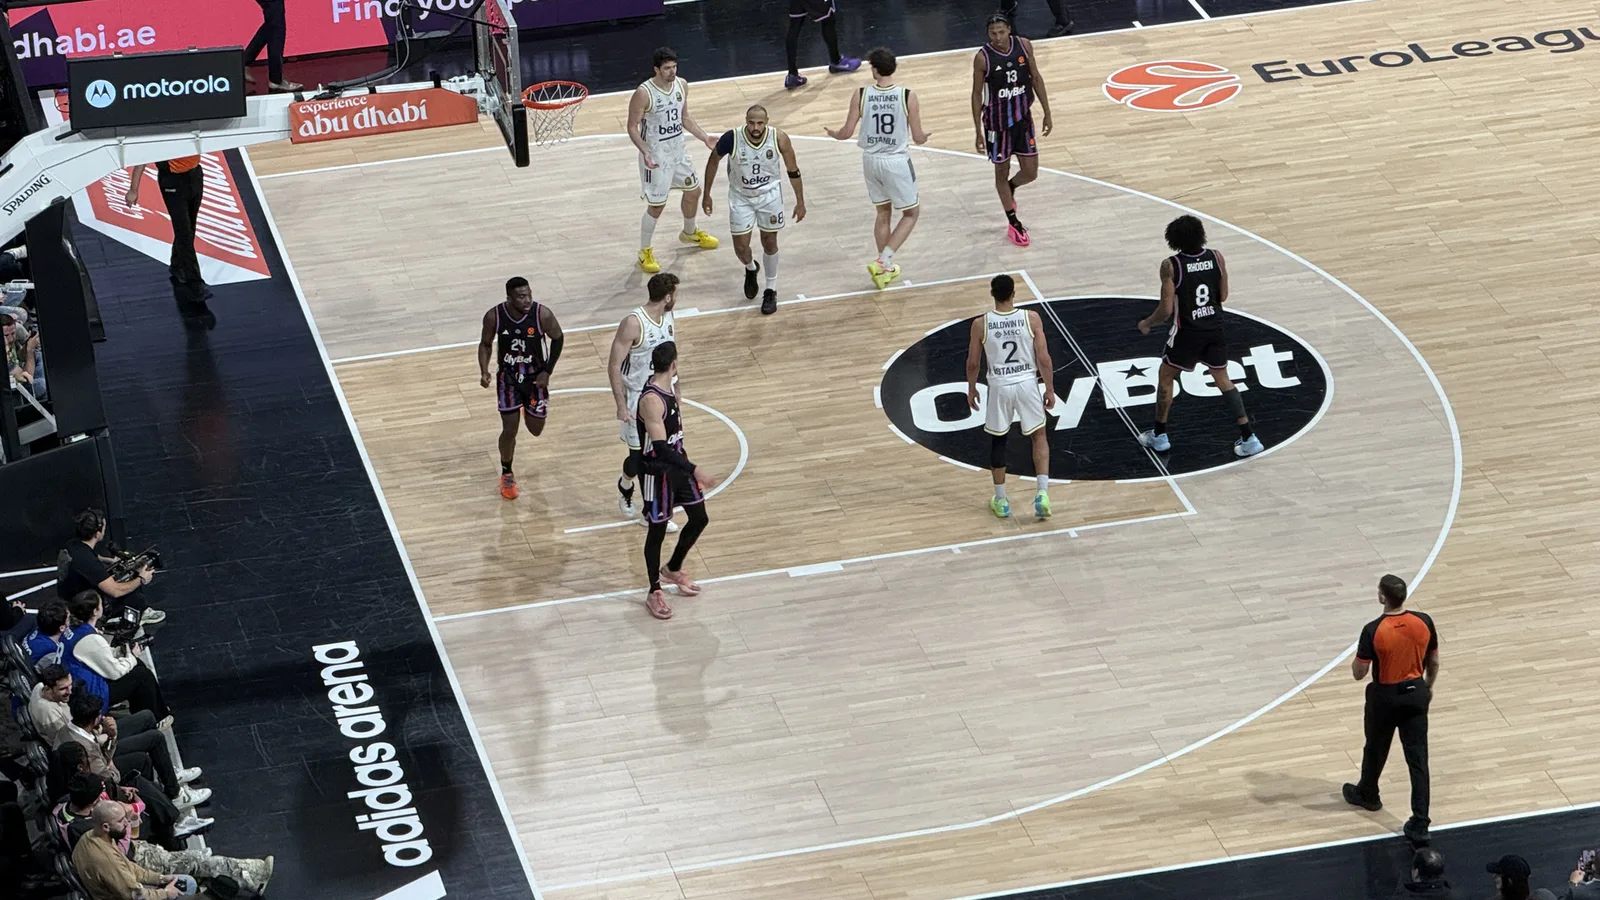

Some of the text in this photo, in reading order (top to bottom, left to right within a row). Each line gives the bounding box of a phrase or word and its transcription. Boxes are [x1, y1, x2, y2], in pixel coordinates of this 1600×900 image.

[1005, 69, 1018, 83] 13
[123, 75, 230, 100] motorola
[998, 84, 1026, 100] OlyBet
[666, 108, 678, 122] 13
[299, 114, 349, 137] abu
[872, 113, 895, 135] 18
[752, 163, 761, 175] 8
[741, 175, 771, 185] beko
[2, 174, 51, 216] SPALDING
[1186, 260, 1214, 273] RHODEN
[1195, 283, 1210, 307] 8
[1191, 305, 1215, 320] PARIS
[988, 320, 1017, 330] BALDWIN
[511, 338, 526, 352] 24
[1002, 340, 1019, 364] 2
[504, 353, 532, 366] OlyBet
[909, 343, 1302, 433] OyBet
[312, 640, 433, 867] adidas arena
